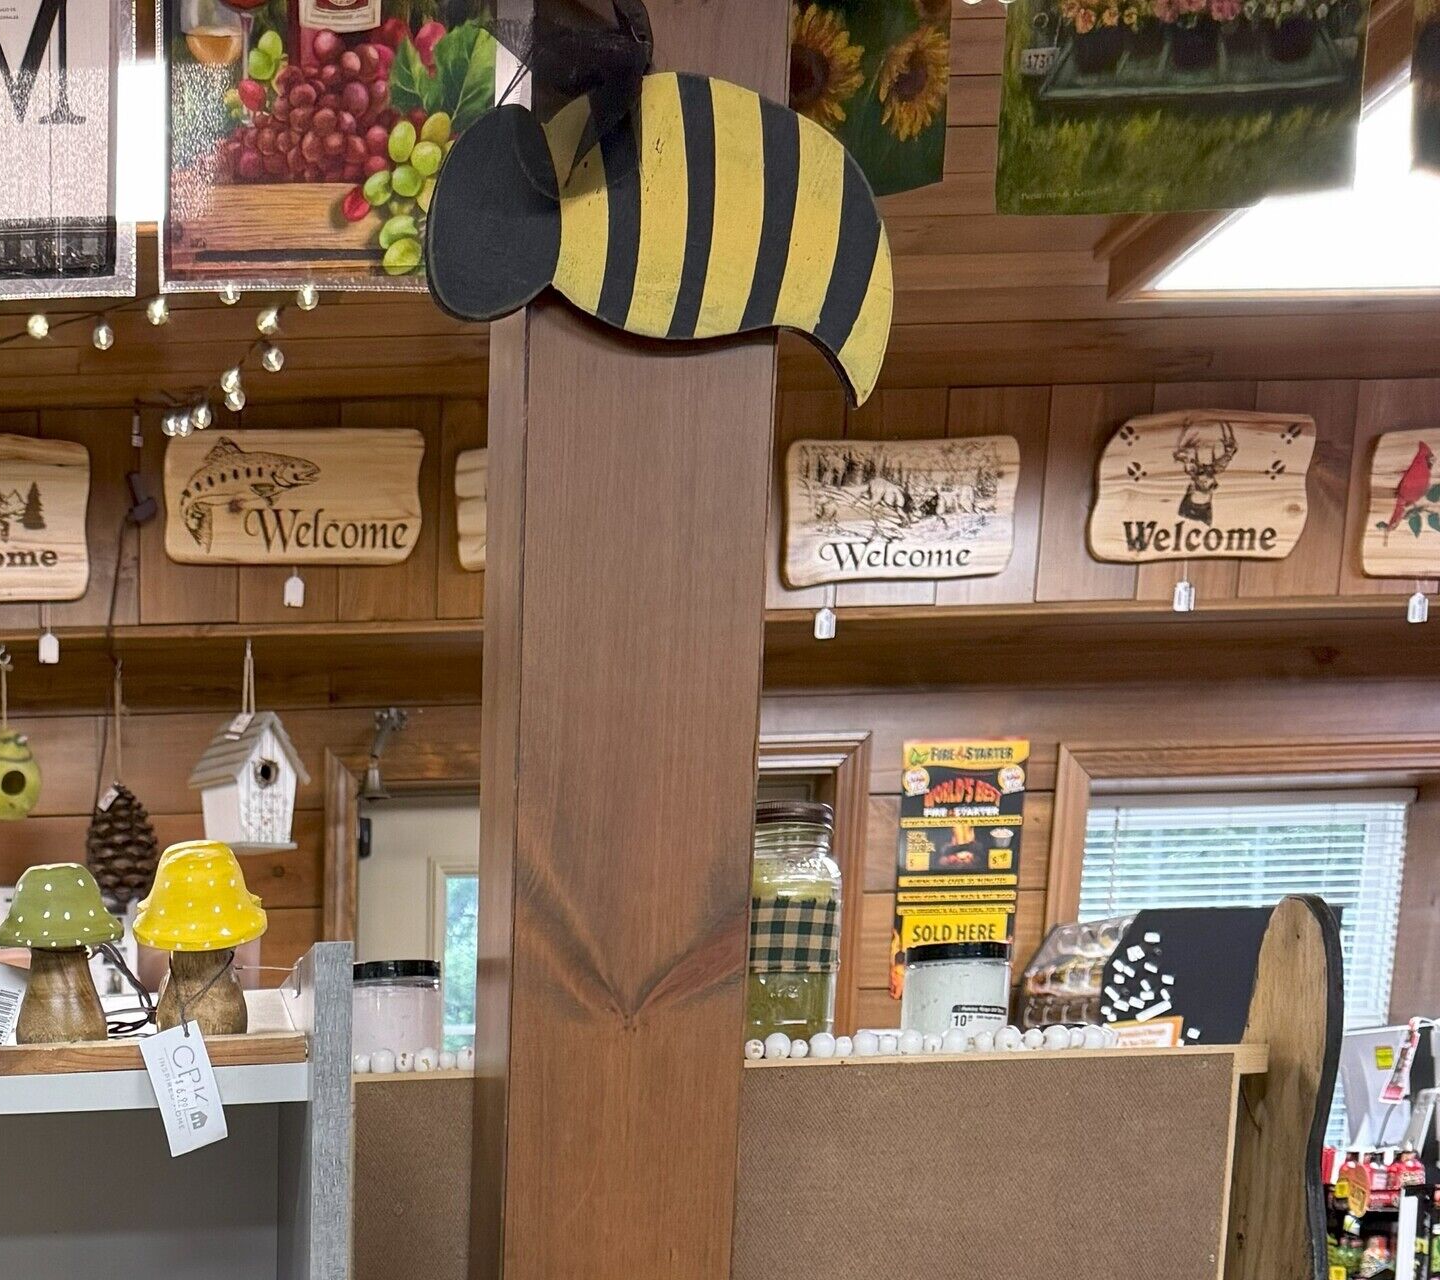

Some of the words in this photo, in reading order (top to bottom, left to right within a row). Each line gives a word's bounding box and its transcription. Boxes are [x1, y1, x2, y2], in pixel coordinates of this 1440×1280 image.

[244, 508, 408, 553] Welcome
[1123, 521, 1277, 553] Welcome
[818, 538, 972, 571] Welcome
[965, 747, 1013, 760] STARTER
[912, 925, 952, 942] SOLD
[956, 923, 996, 940] HERE
[172, 1045, 209, 1103] CPK
